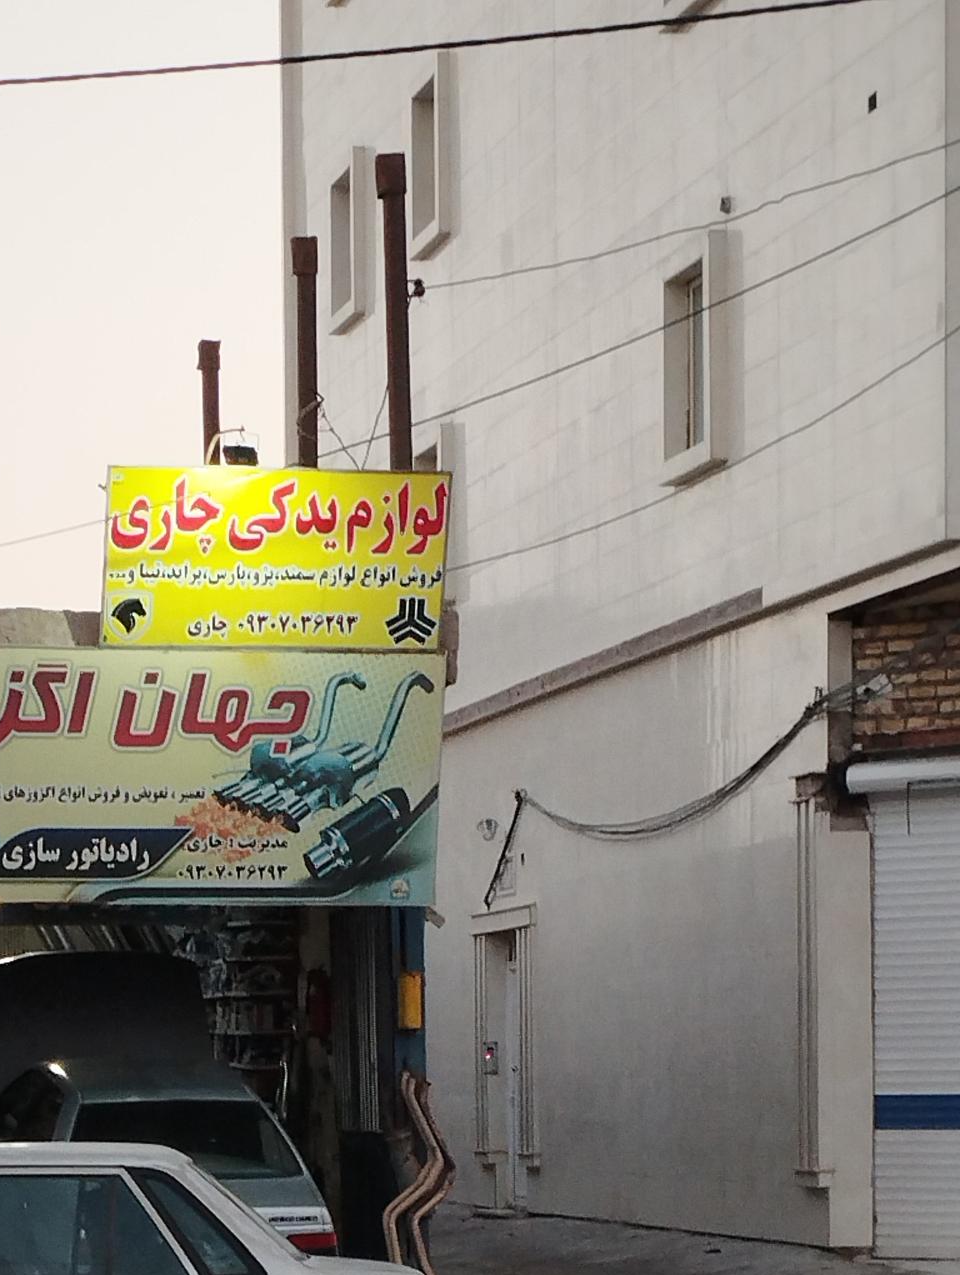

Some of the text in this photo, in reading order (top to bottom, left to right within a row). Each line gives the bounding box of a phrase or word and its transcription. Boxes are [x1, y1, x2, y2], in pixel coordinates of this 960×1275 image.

[110, 479, 448, 555] لوازم یدکی چاری
[319, 564, 356, 587] لوازم
[359, 565, 396, 587] انواع
[399, 564, 442, 588] فروش
[112, 671, 311, 755] جهان
[58, 785, 85, 803] انواع
[88, 785, 121, 803] فروش
[132, 786, 168, 803] تعویض
[178, 787, 205, 803] تعمیر
[1, 836, 150, 871] رادیاتور سازی
[237, 836, 288, 853] مدیریت
